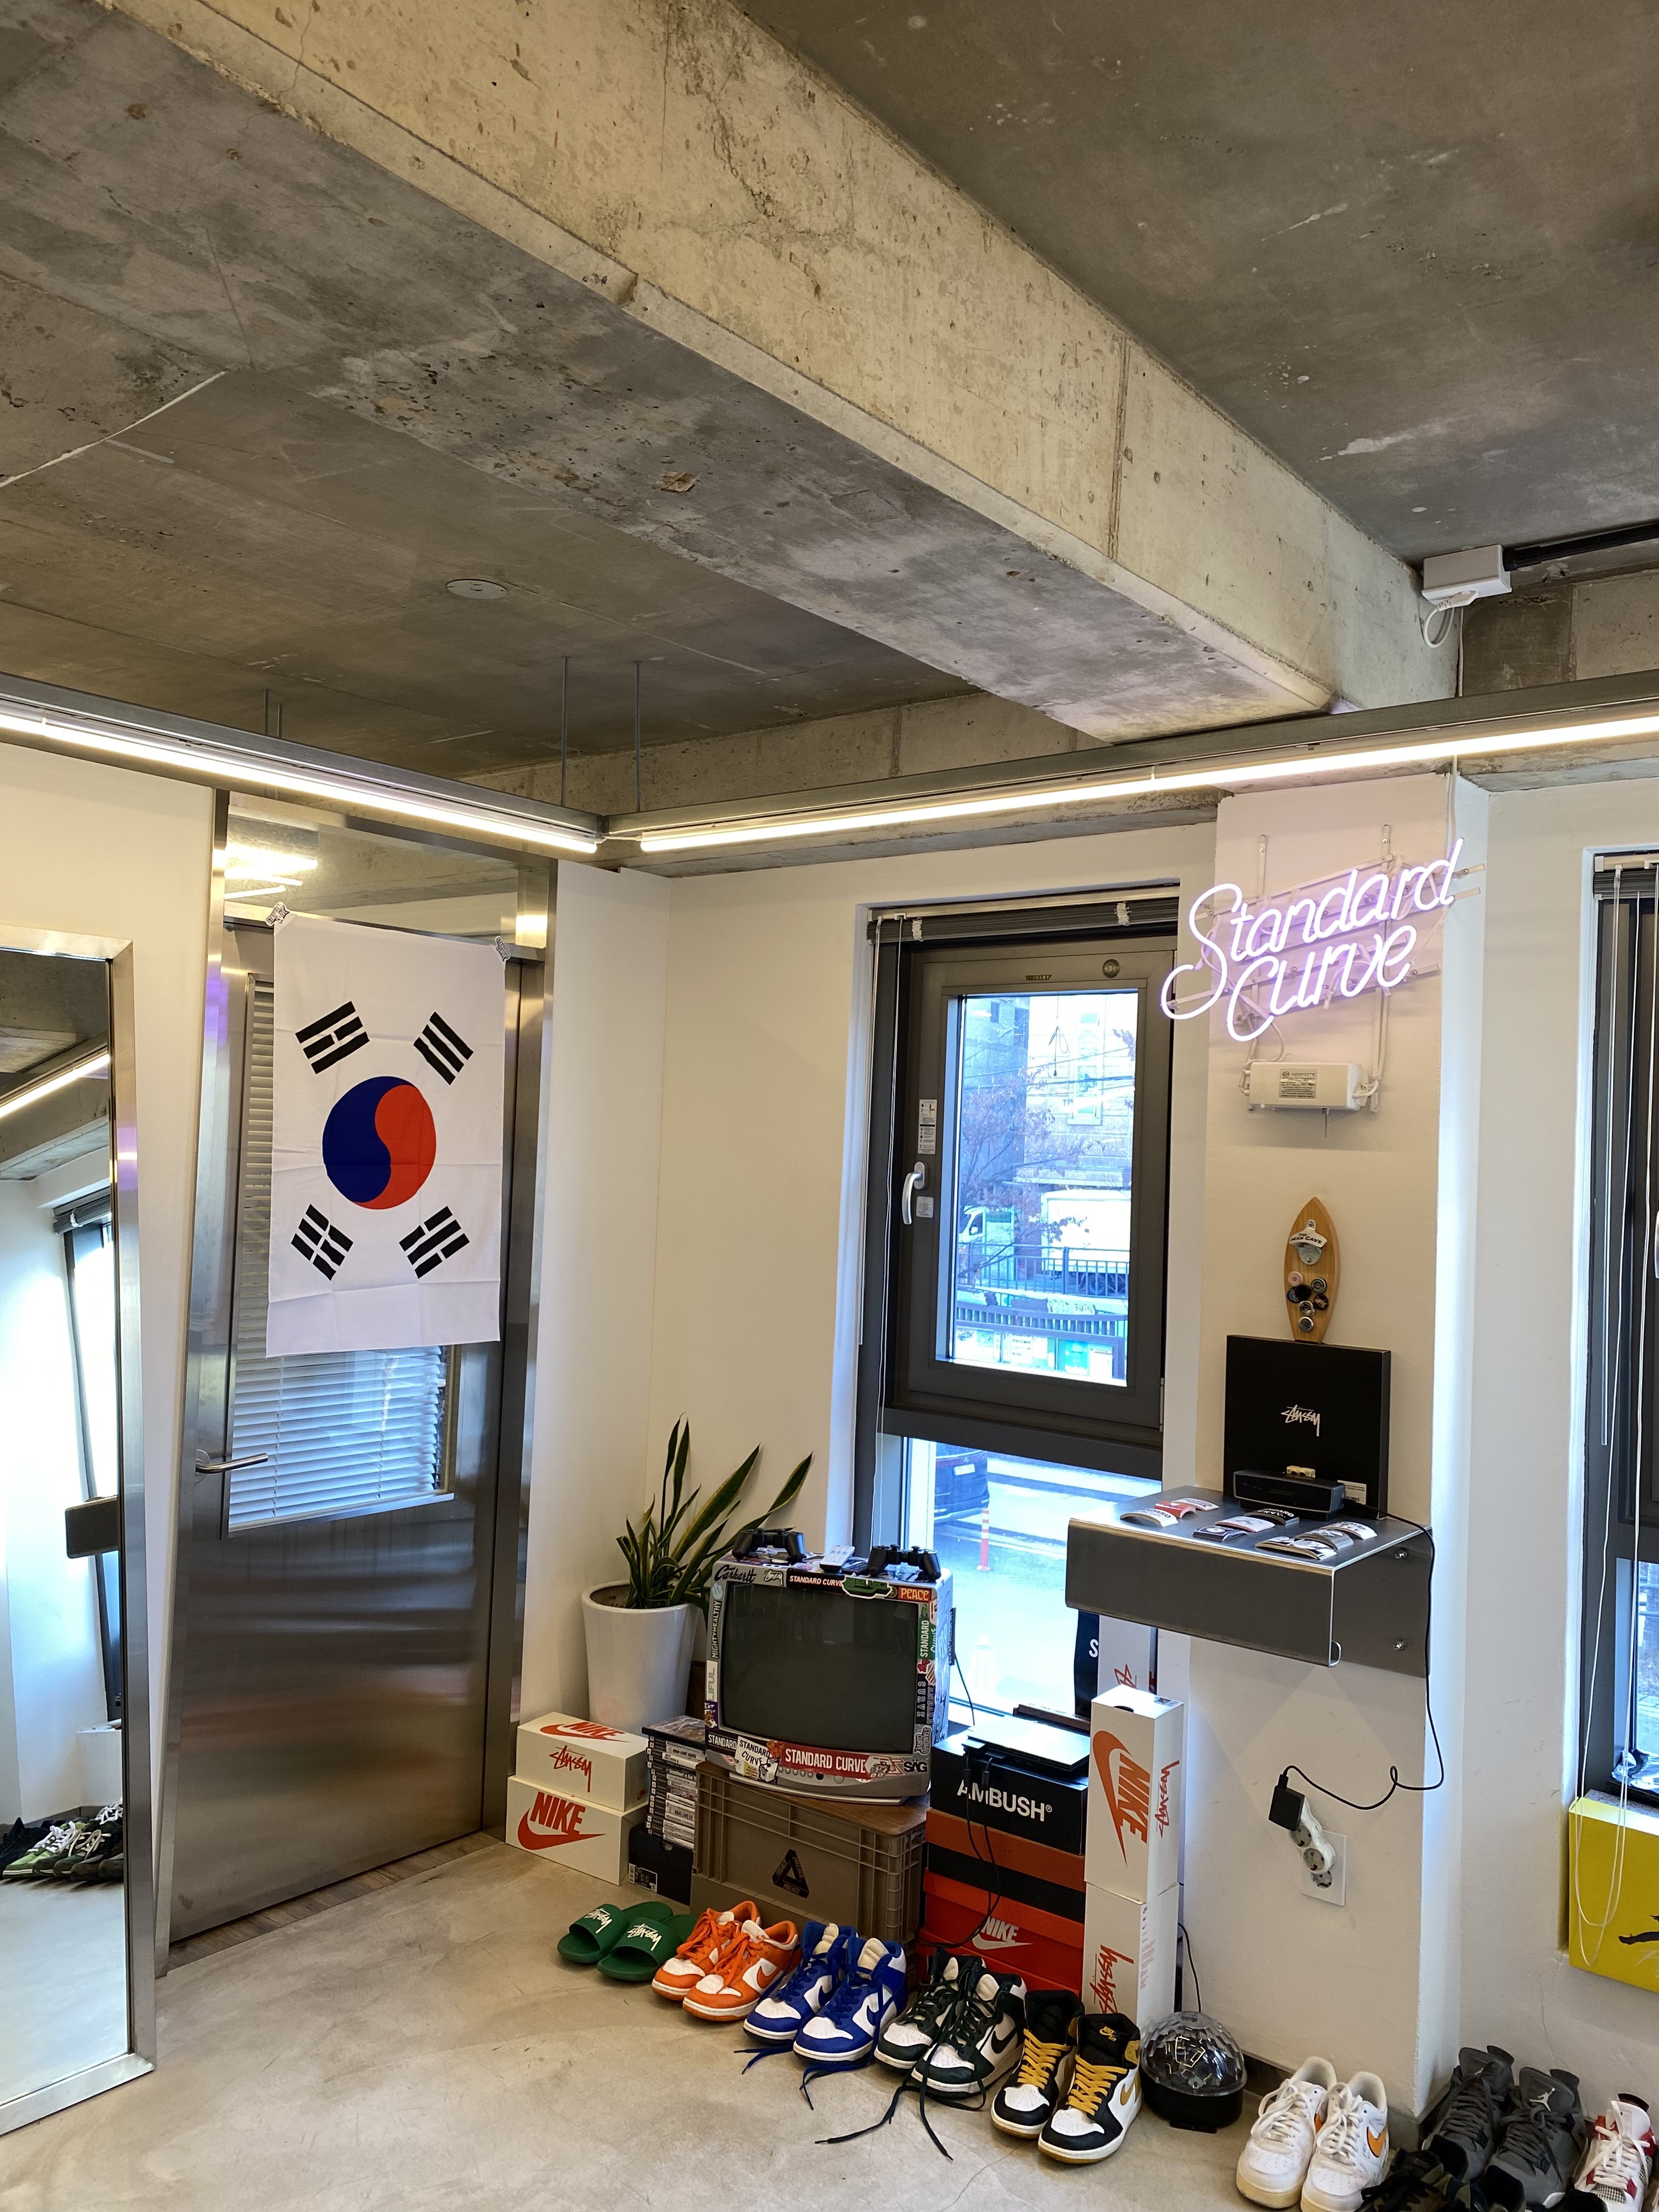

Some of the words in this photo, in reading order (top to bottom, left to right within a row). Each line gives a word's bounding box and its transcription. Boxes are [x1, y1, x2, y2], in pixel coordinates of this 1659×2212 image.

[1161, 838, 1464, 1020] Standard
[1305, 1236, 1323, 1245] CAVE
[714, 1564, 757, 1583] Carhartt
[789, 1575, 822, 1585] STANDARD
[900, 1588, 930, 1601] PEACE
[920, 1620, 930, 1658] STANDARD
[917, 1681, 927, 1718] CURVE
[562, 1721, 627, 1740] NIKE
[708, 1734, 737, 1750] STANDARD
[740, 1740, 771, 1758] STANDARD
[785, 1748, 833, 1769] STANDARD
[836, 1756, 866, 1774] CURVE
[1118, 1752, 1150, 1844] NIKE
[529, 1791, 586, 1835] NIKE
[783, 1883, 802, 1895] PALACE
[980, 1915, 1019, 1943] NIKE
